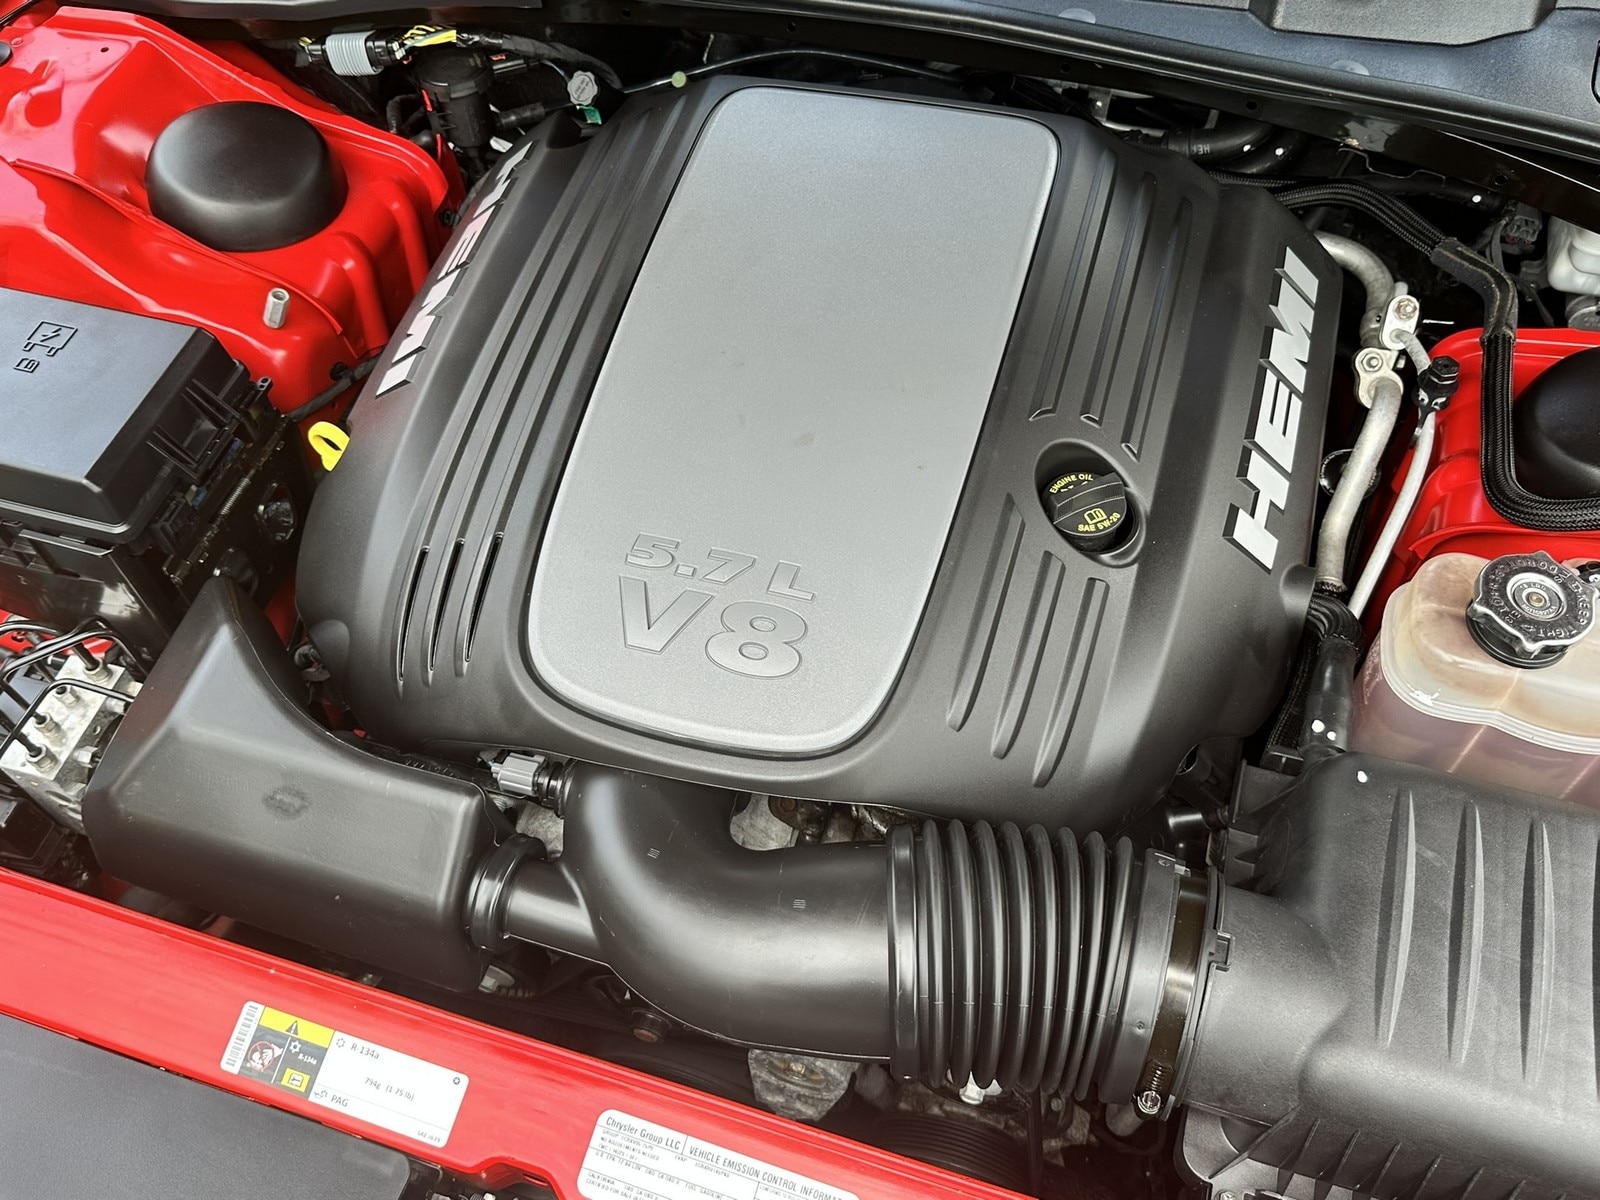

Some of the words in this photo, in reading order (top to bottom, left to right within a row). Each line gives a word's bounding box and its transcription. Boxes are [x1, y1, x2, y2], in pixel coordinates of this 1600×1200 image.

[376, 141, 536, 399] HEMI
[1226, 246, 1319, 572] HEMI
[1049, 474, 1077, 494] ENGINE
[1078, 524, 1096, 532] SAE
[1096, 512, 1120, 530] 5W-20
[625, 532, 757, 585] 5.7
[766, 560, 816, 603] L
[1577, 594, 1590, 626] KEEP
[619, 575, 808, 679] V8
[1538, 625, 1578, 638] TIGHT
[364, 1077, 382, 1090] 794g
[330, 1094, 349, 1108] PAG
[606, 1116, 638, 1135] Chrysler
[640, 1128, 664, 1145] Group
[665, 1137, 681, 1150] LLC
[689, 1145, 721, 1164] VEHICLE
[722, 1157, 760, 1178] EMISSION
[762, 1171, 796, 1192] CONTROL
